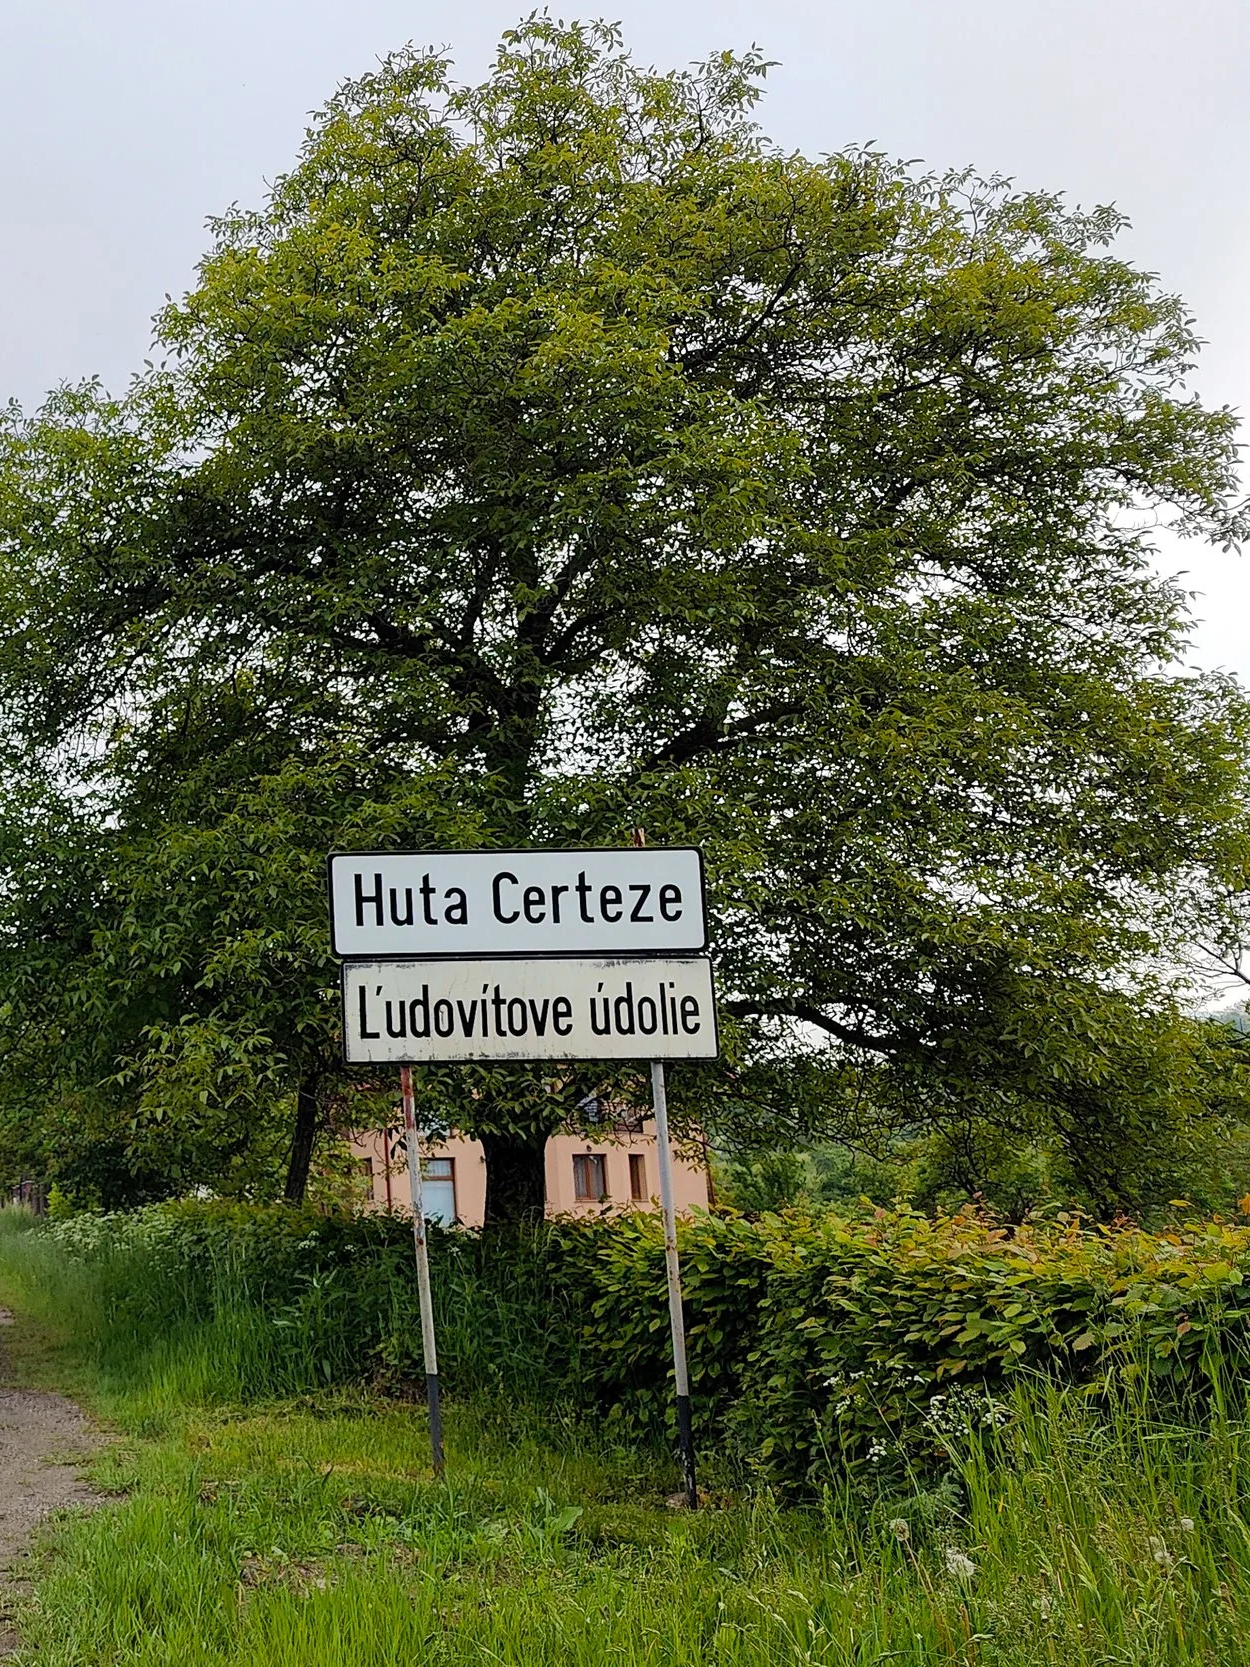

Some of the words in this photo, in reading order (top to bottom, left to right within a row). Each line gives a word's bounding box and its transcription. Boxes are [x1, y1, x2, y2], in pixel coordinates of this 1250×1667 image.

[353, 872, 468, 927] Huta
[491, 870, 683, 924] Certeze
[590, 981, 701, 1036] údolie
